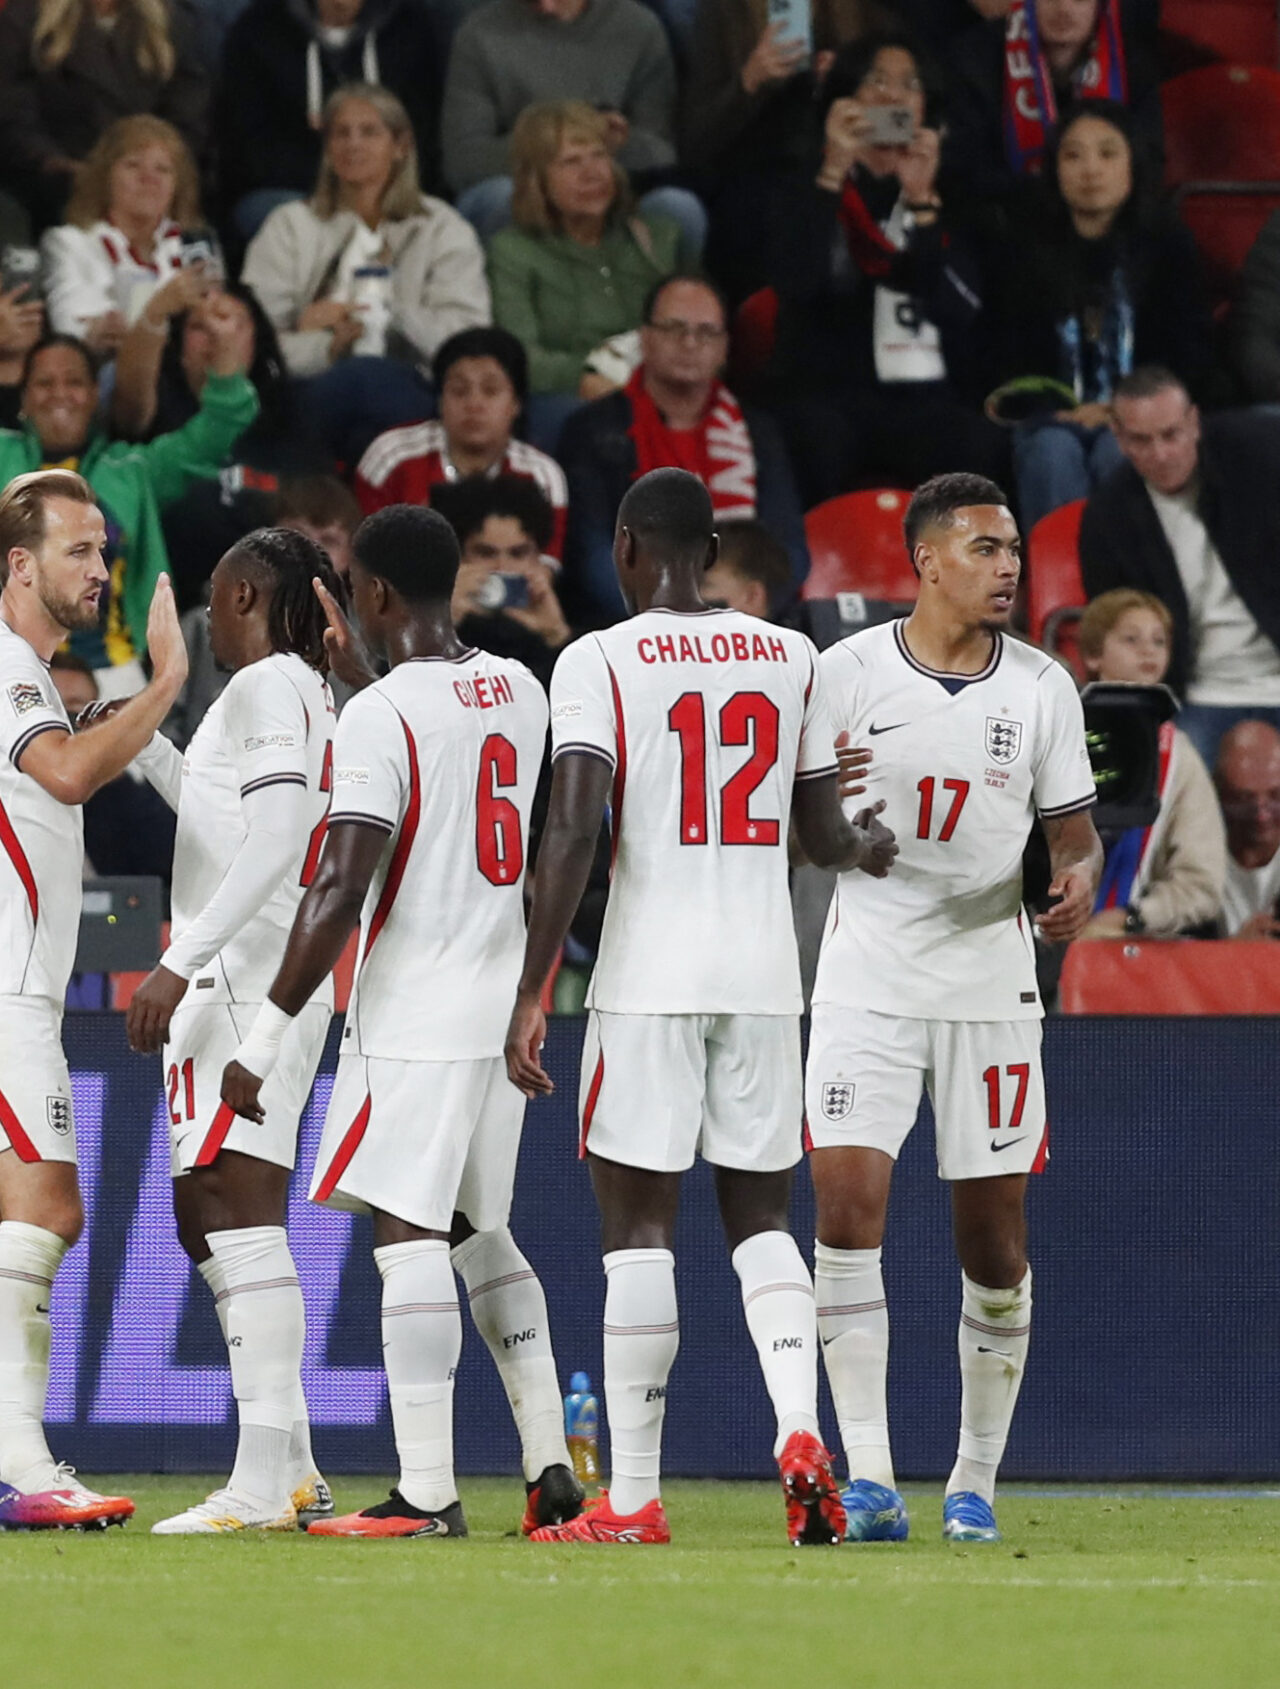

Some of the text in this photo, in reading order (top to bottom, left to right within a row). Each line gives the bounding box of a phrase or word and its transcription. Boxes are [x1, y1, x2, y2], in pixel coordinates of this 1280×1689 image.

[637, 633, 788, 664] CHALOBAH
[668, 691, 780, 846] 12
[476, 733, 523, 887] 6
[916, 775, 970, 842] 17
[166, 1057, 195, 1125] 21
[982, 1062, 1030, 1129] 17
[503, 1327, 536, 1350] ENG
[773, 1337, 803, 1352] ENG
